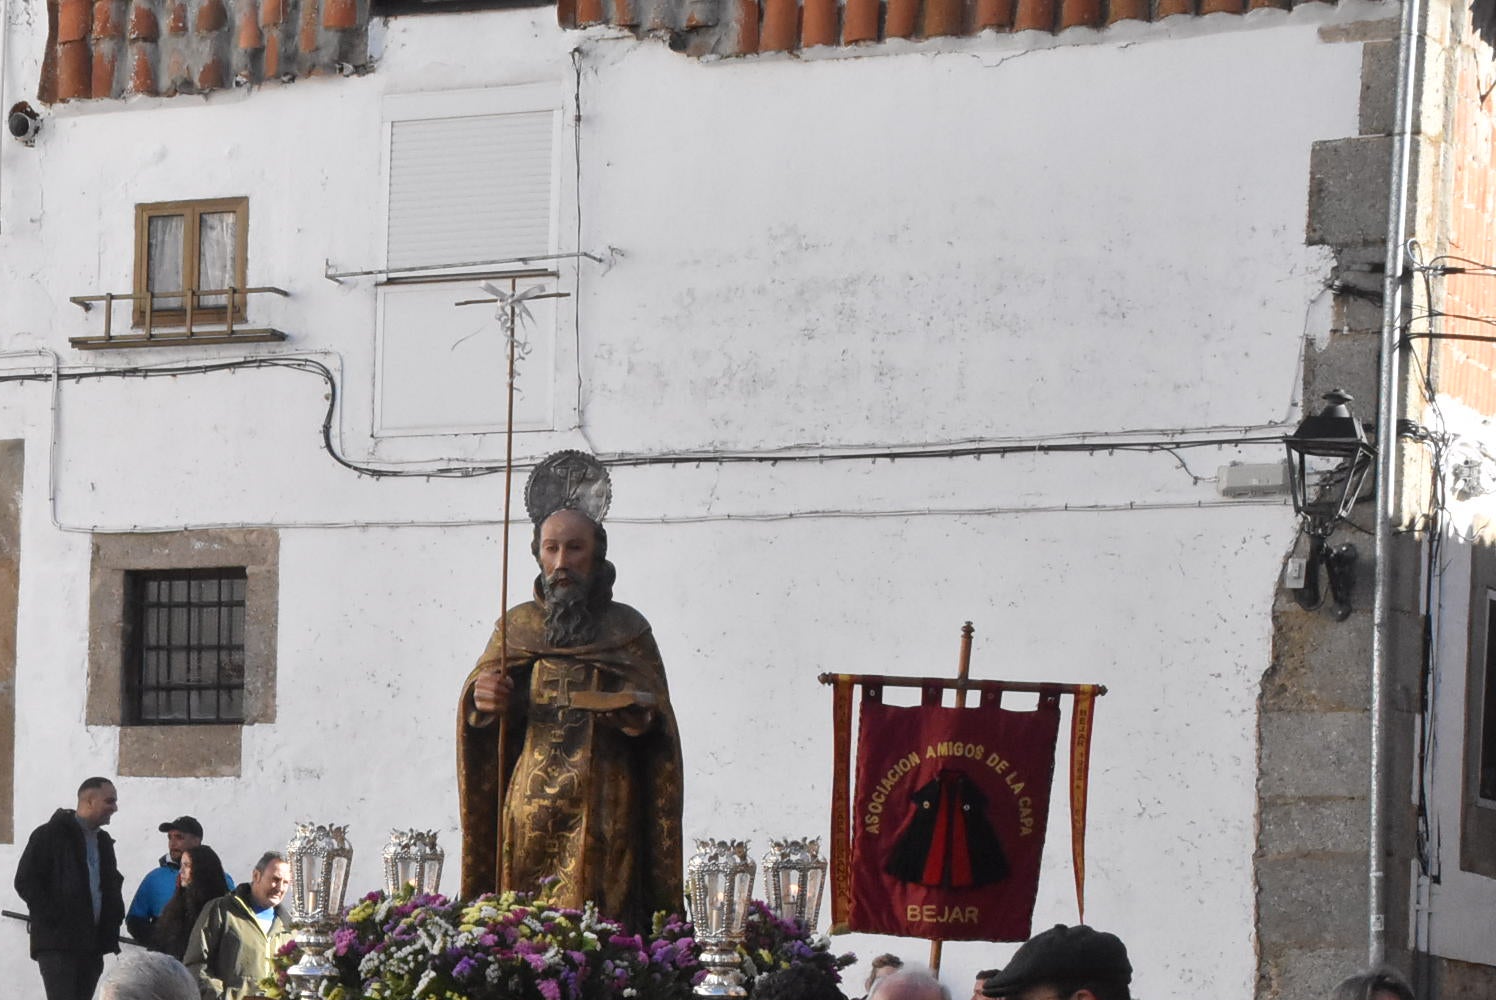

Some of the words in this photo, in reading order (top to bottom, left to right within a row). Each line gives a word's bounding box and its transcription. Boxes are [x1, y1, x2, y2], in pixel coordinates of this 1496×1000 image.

[865, 751, 921, 834] ASOCIACION
[925, 741, 984, 760] AMIGOS
[985, 753, 1009, 774] DE
[1005, 772, 1025, 795] LA
[1019, 797, 1035, 836] CAPA
[906, 904, 979, 923] BEJAR
